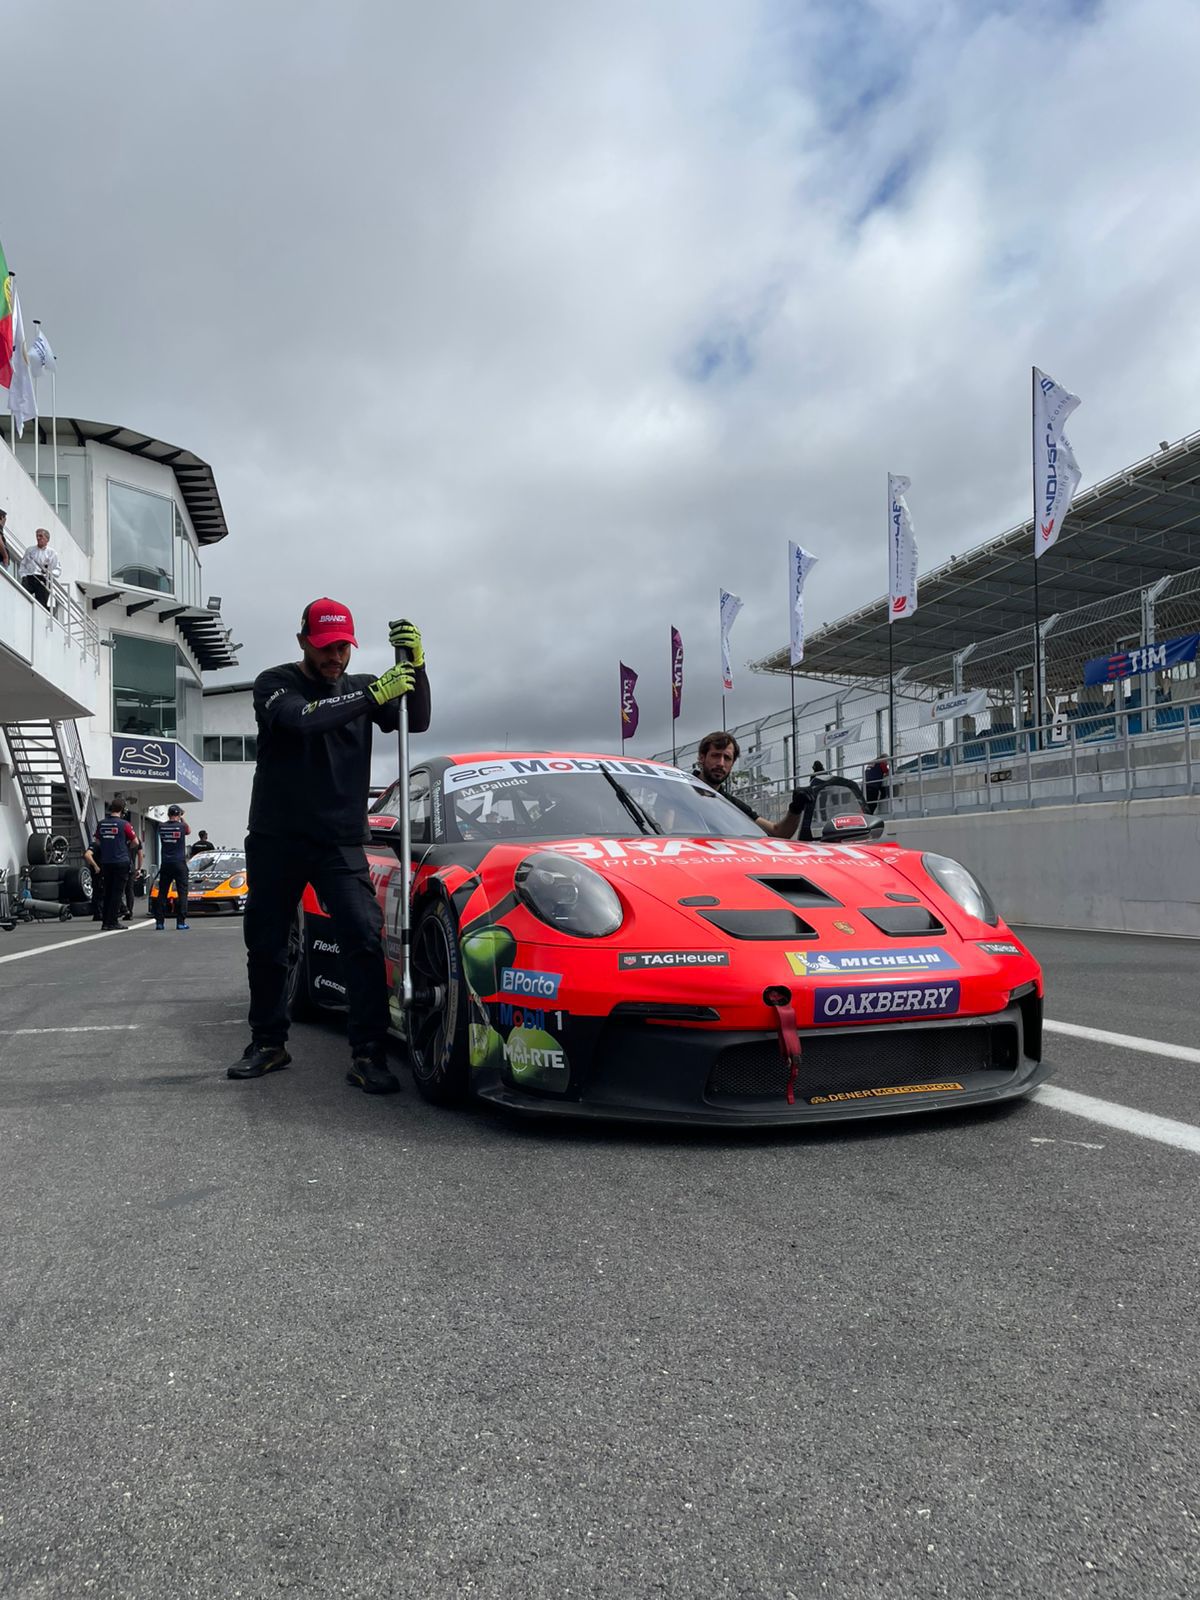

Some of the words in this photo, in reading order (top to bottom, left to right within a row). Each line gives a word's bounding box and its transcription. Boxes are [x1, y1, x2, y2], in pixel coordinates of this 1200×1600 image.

[1128, 644, 1167, 673] TIM
[120, 766, 147, 775] Circuito
[148, 769, 170, 777] Estoril
[508, 758, 622, 774] Mobil
[461, 788, 479, 797] M.
[480, 778, 528, 791] Paludo
[545, 838, 870, 860] BRANDT
[603, 854, 761, 869] Professional
[772, 855, 898, 868] Agriculture
[841, 953, 941, 967] MICHELIN
[514, 971, 555, 995] Porto
[823, 986, 953, 1016] OAKBERRY
[500, 1003, 545, 1031] Mobil
[554, 1010, 563, 1031] 1
[827, 1090, 873, 1102] DENER
[874, 1083, 960, 1097] MOTORSPORT
